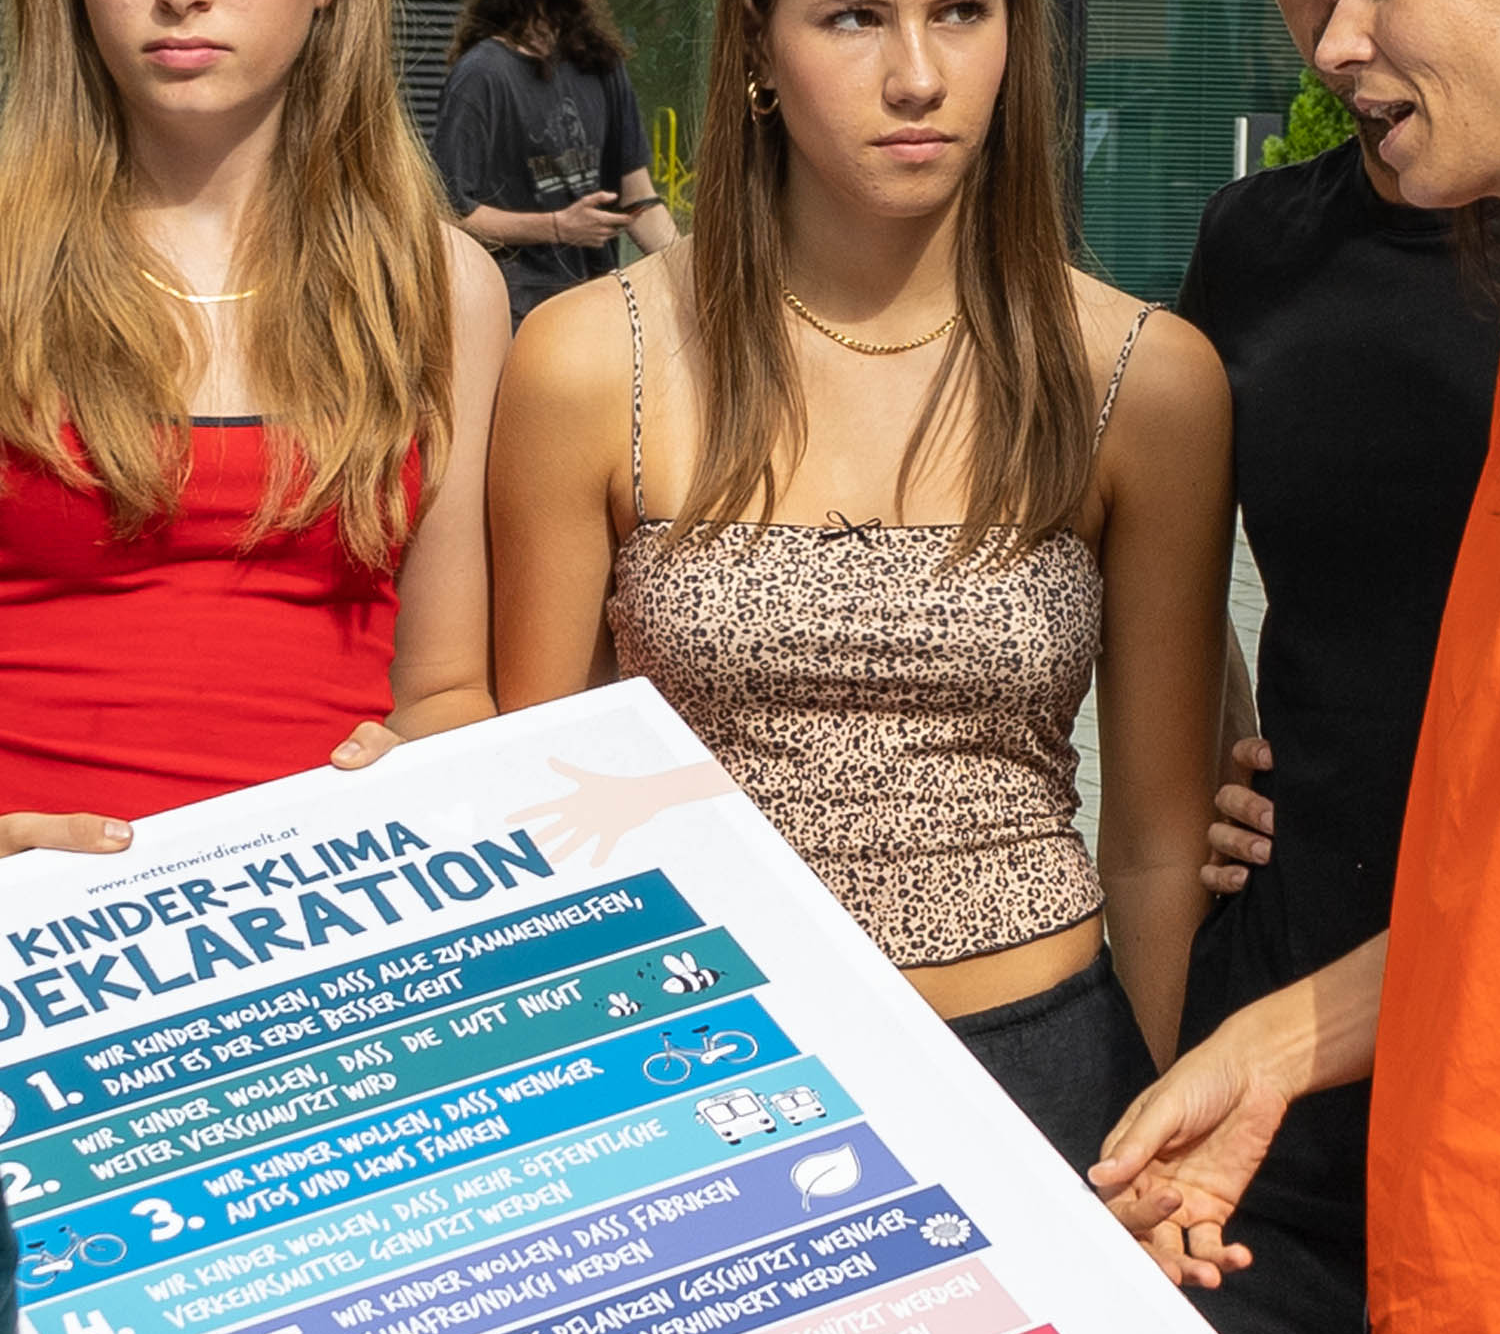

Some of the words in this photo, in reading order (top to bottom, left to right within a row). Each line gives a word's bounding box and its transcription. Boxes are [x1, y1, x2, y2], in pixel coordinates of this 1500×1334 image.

[6, 820, 431, 967] KINDER-KLIMA
[86, 826, 299, 895] www.rettenwirdiewelt.at
[84, 1044, 136, 1071] WIR
[131, 1017, 222, 1057] KINDER
[216, 987, 320, 1030] WOLLEN,
[319, 967, 376, 1000] DASS
[378, 951, 434, 984] ALLE
[431, 889, 643, 964] ZUSAMMENHELFEN,
[101, 1055, 176, 1096] DAMIT
[179, 1047, 212, 1071] ES
[211, 1034, 264, 1063] DER
[260, 1015, 321, 1047] ERDE
[318, 991, 406, 1031] BESSER
[403, 967, 463, 1003] GEHT
[26, 1070, 84, 1111] 1.
[71, 1126, 125, 1155] WIR
[128, 1097, 221, 1138] KINDER
[223, 1063, 329, 1107] WOLLEN,
[336, 1040, 393, 1073] DASS
[400, 1026, 443, 1053] DIE
[448, 1001, 507, 1038] LUFT
[516, 978, 582, 1018] NICHT
[89, 1139, 184, 1180] WEITER
[179, 1083, 339, 1152] VERSCHMUTZT
[340, 1072, 397, 1101] WIRD
[202, 1168, 256, 1197] WIR
[250, 1140, 343, 1183] KINDER
[336, 1108, 442, 1154] WOLLEN,
[441, 1087, 498, 1121] DASS
[495, 1057, 604, 1103] WENIGER
[226, 1182, 300, 1225] AUTOS
[299, 1169, 350, 1198] UND
[352, 1144, 417, 1181] LKWS
[415, 1114, 510, 1163] FAHREN
[130, 1197, 206, 1242] 3.
[143, 1272, 197, 1302] WIR
[194, 1243, 288, 1286] KINDER
[283, 1209, 391, 1256] WOLLEN,
[391, 1187, 449, 1222] DASS
[452, 1166, 523, 1204] MEHR
[519, 1117, 668, 1177] ÖFFENTLICHE
[162, 1249, 366, 1328] VERKEHRSMITTEL
[369, 1207, 475, 1260] GENUTZT
[476, 1178, 573, 1225] WERDEN
[331, 1298, 385, 1328] WIR
[379, 1269, 473, 1313] KINDER
[466, 1235, 573, 1282] WOLLEN,
[571, 1213, 629, 1248] DASS
[627, 1176, 740, 1231] FABRIKEN
[556, 1237, 654, 1285] WERDEN
[679, 1241, 810, 1302] GESCHÜTZT,
[808, 1207, 917, 1256] WENIGER
[781, 1250, 877, 1299] WERDEN
[886, 1271, 981, 1319] WERDEN
